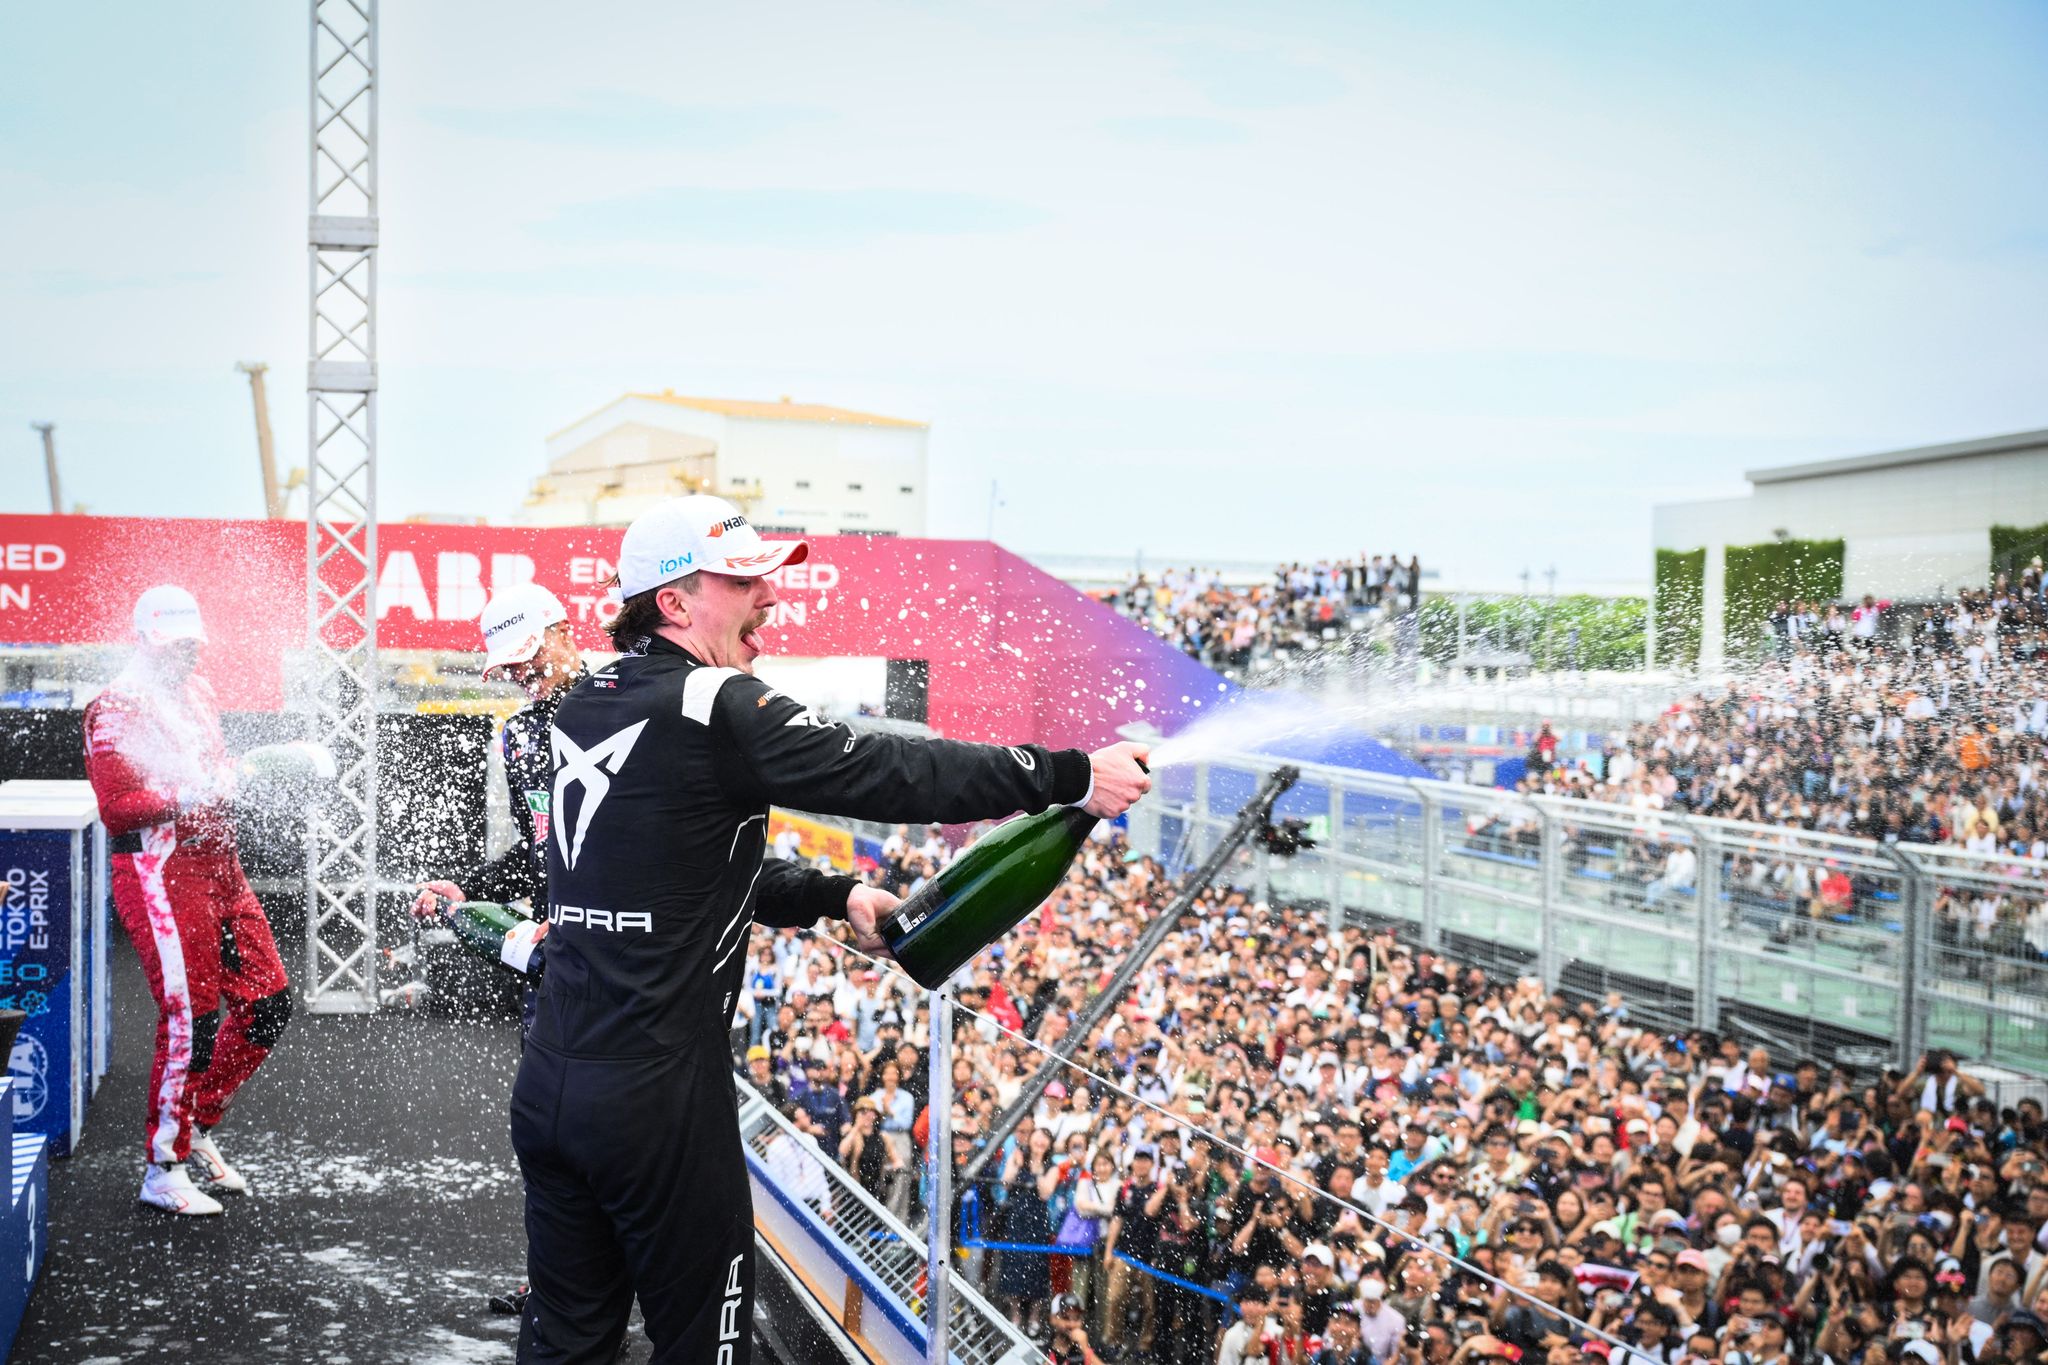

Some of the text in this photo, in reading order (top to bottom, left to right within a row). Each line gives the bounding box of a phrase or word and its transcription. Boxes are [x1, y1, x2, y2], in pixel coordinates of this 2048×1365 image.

[0, 543, 66, 571] ED
[6, 867, 27, 951] TOKYO
[29, 869, 49, 950] E-PRIX
[8, 1041, 34, 1116] FIA
